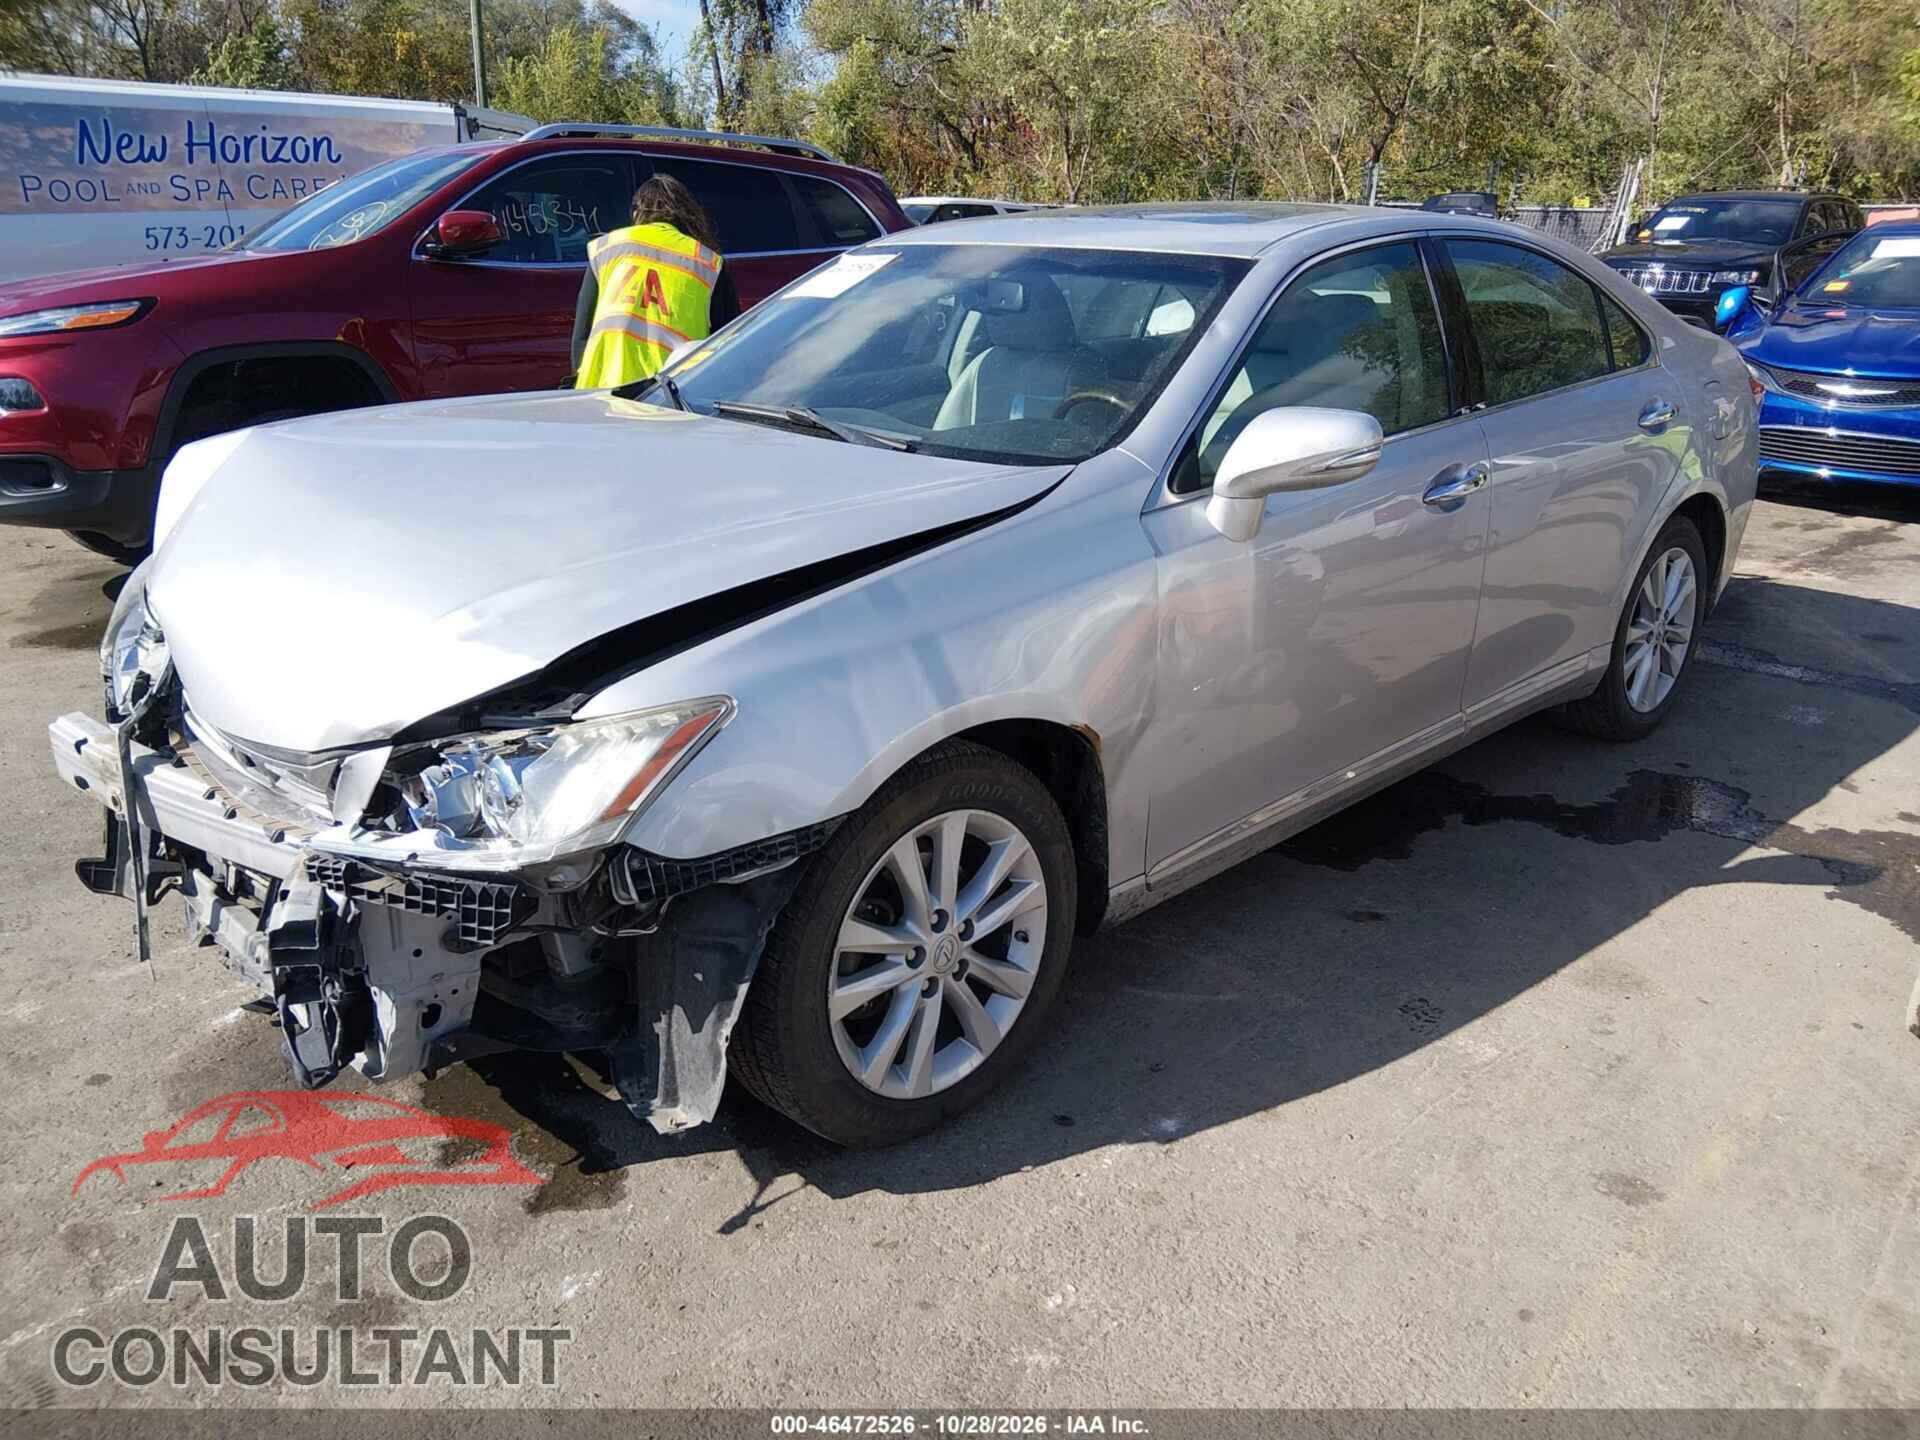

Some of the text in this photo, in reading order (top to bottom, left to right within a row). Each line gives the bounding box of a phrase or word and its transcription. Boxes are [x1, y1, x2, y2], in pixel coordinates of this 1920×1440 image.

[78, 118, 341, 165] New Horizon
[19, 174, 121, 203] POOL
[126, 181, 161, 196] AND
[169, 174, 235, 202] SPA
